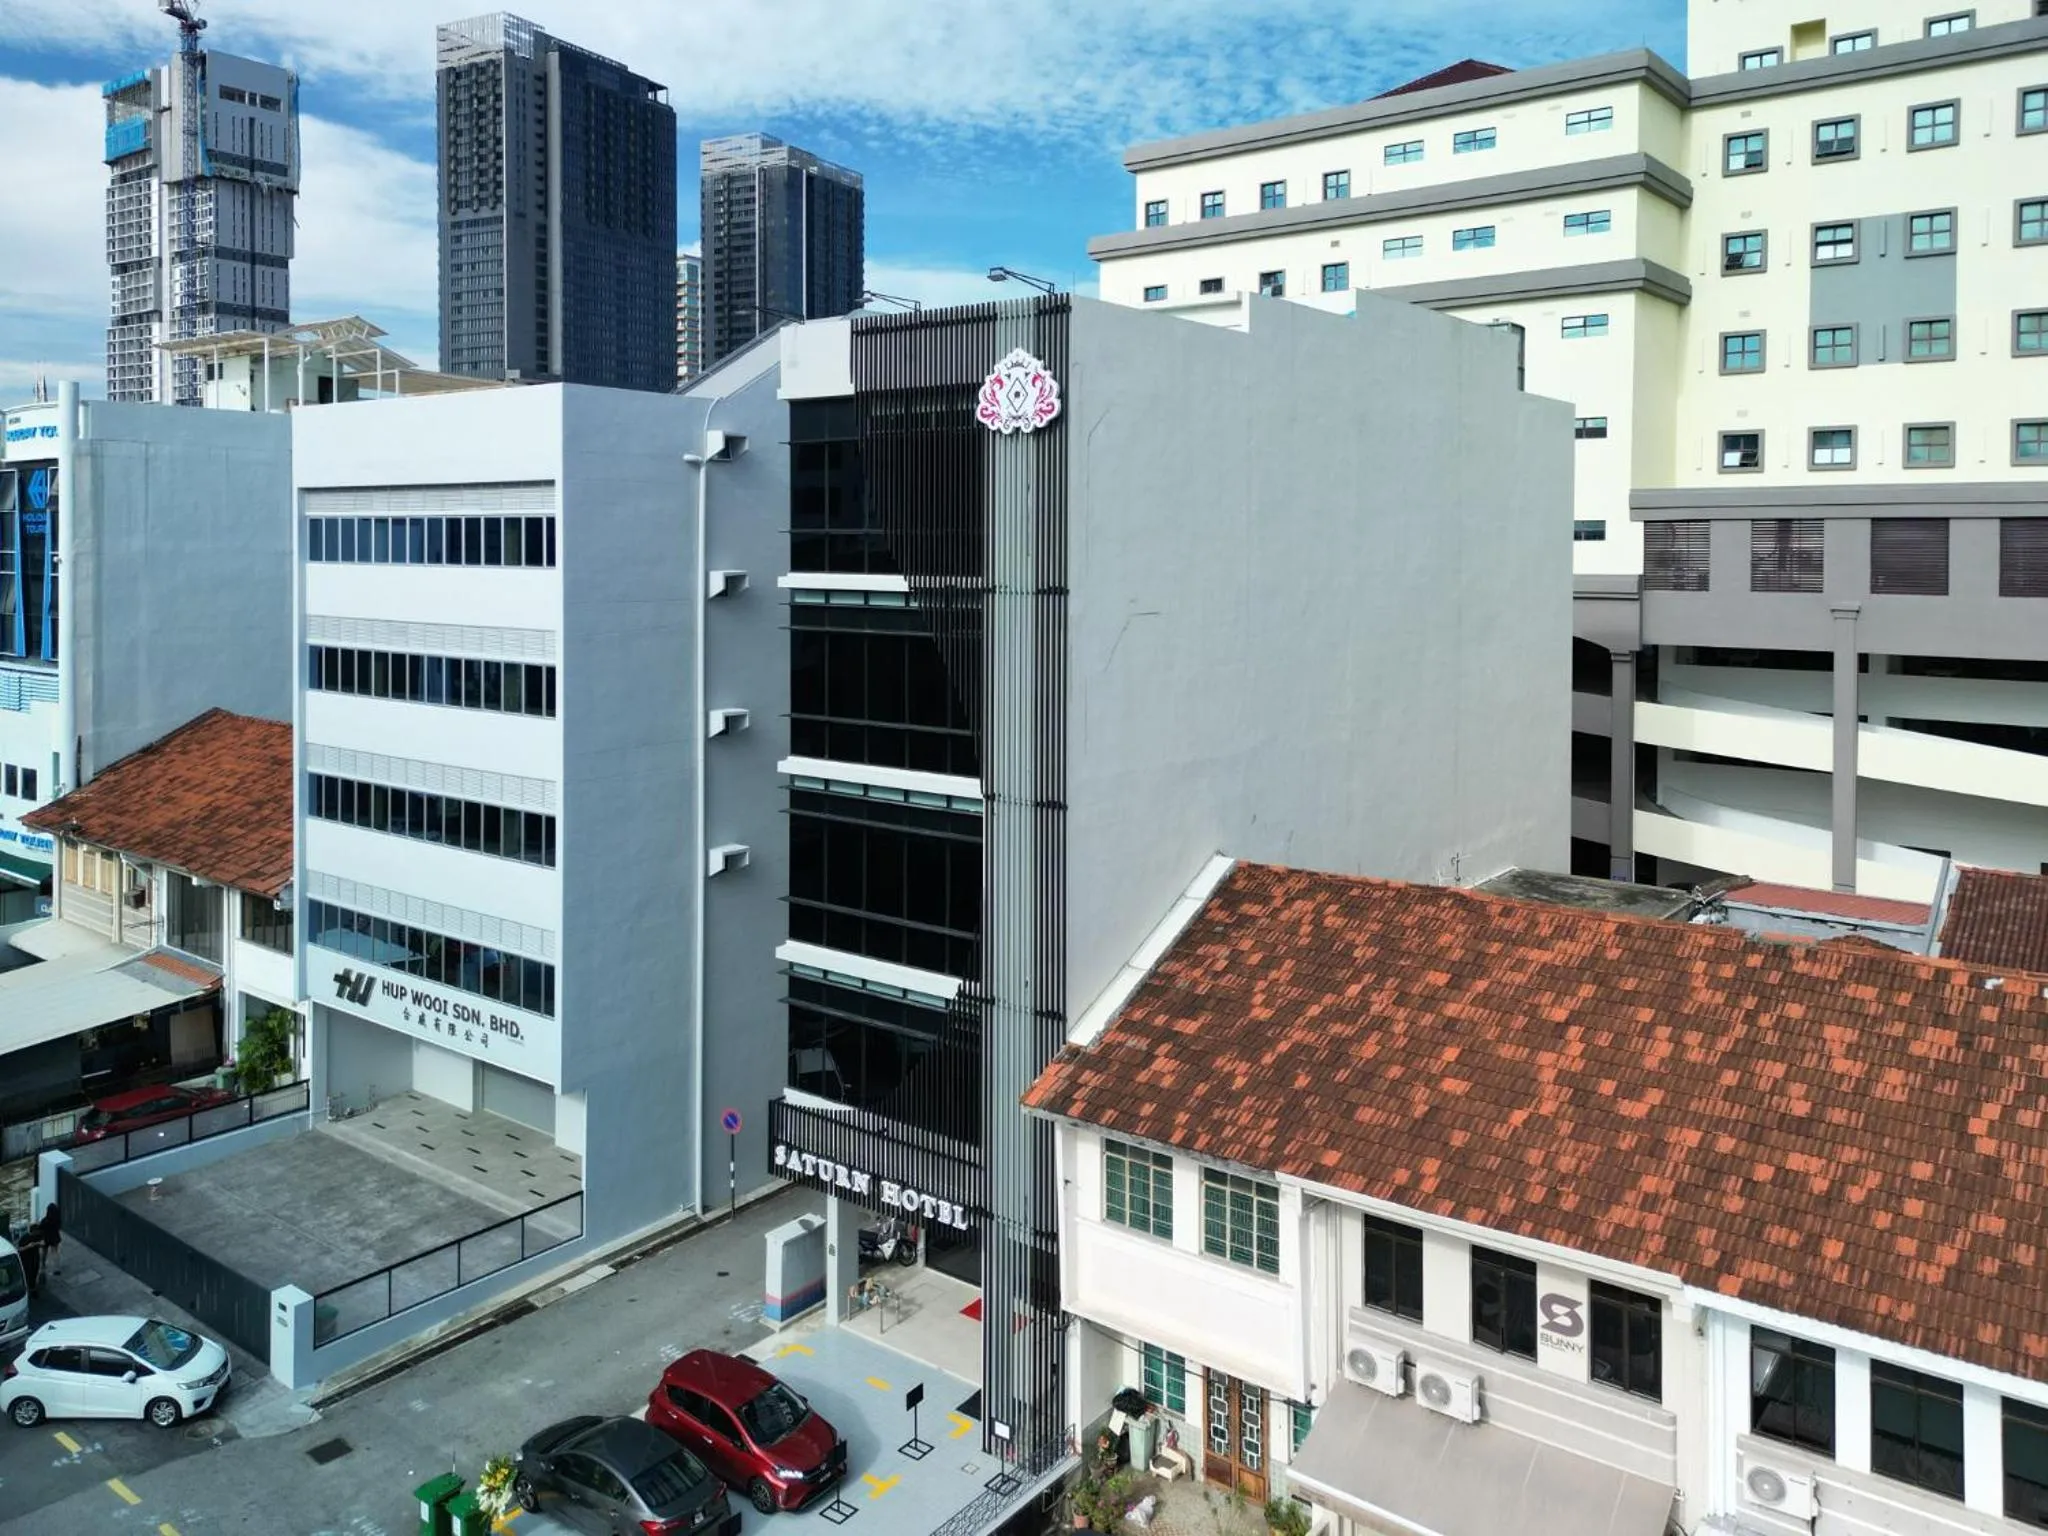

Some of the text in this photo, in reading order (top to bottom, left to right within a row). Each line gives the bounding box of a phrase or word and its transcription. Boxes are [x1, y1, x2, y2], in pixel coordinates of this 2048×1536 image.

[381, 979, 525, 1041] HUP WOOI SDN. BHD.
[774, 1144, 970, 1231] SATURN HOTEL
